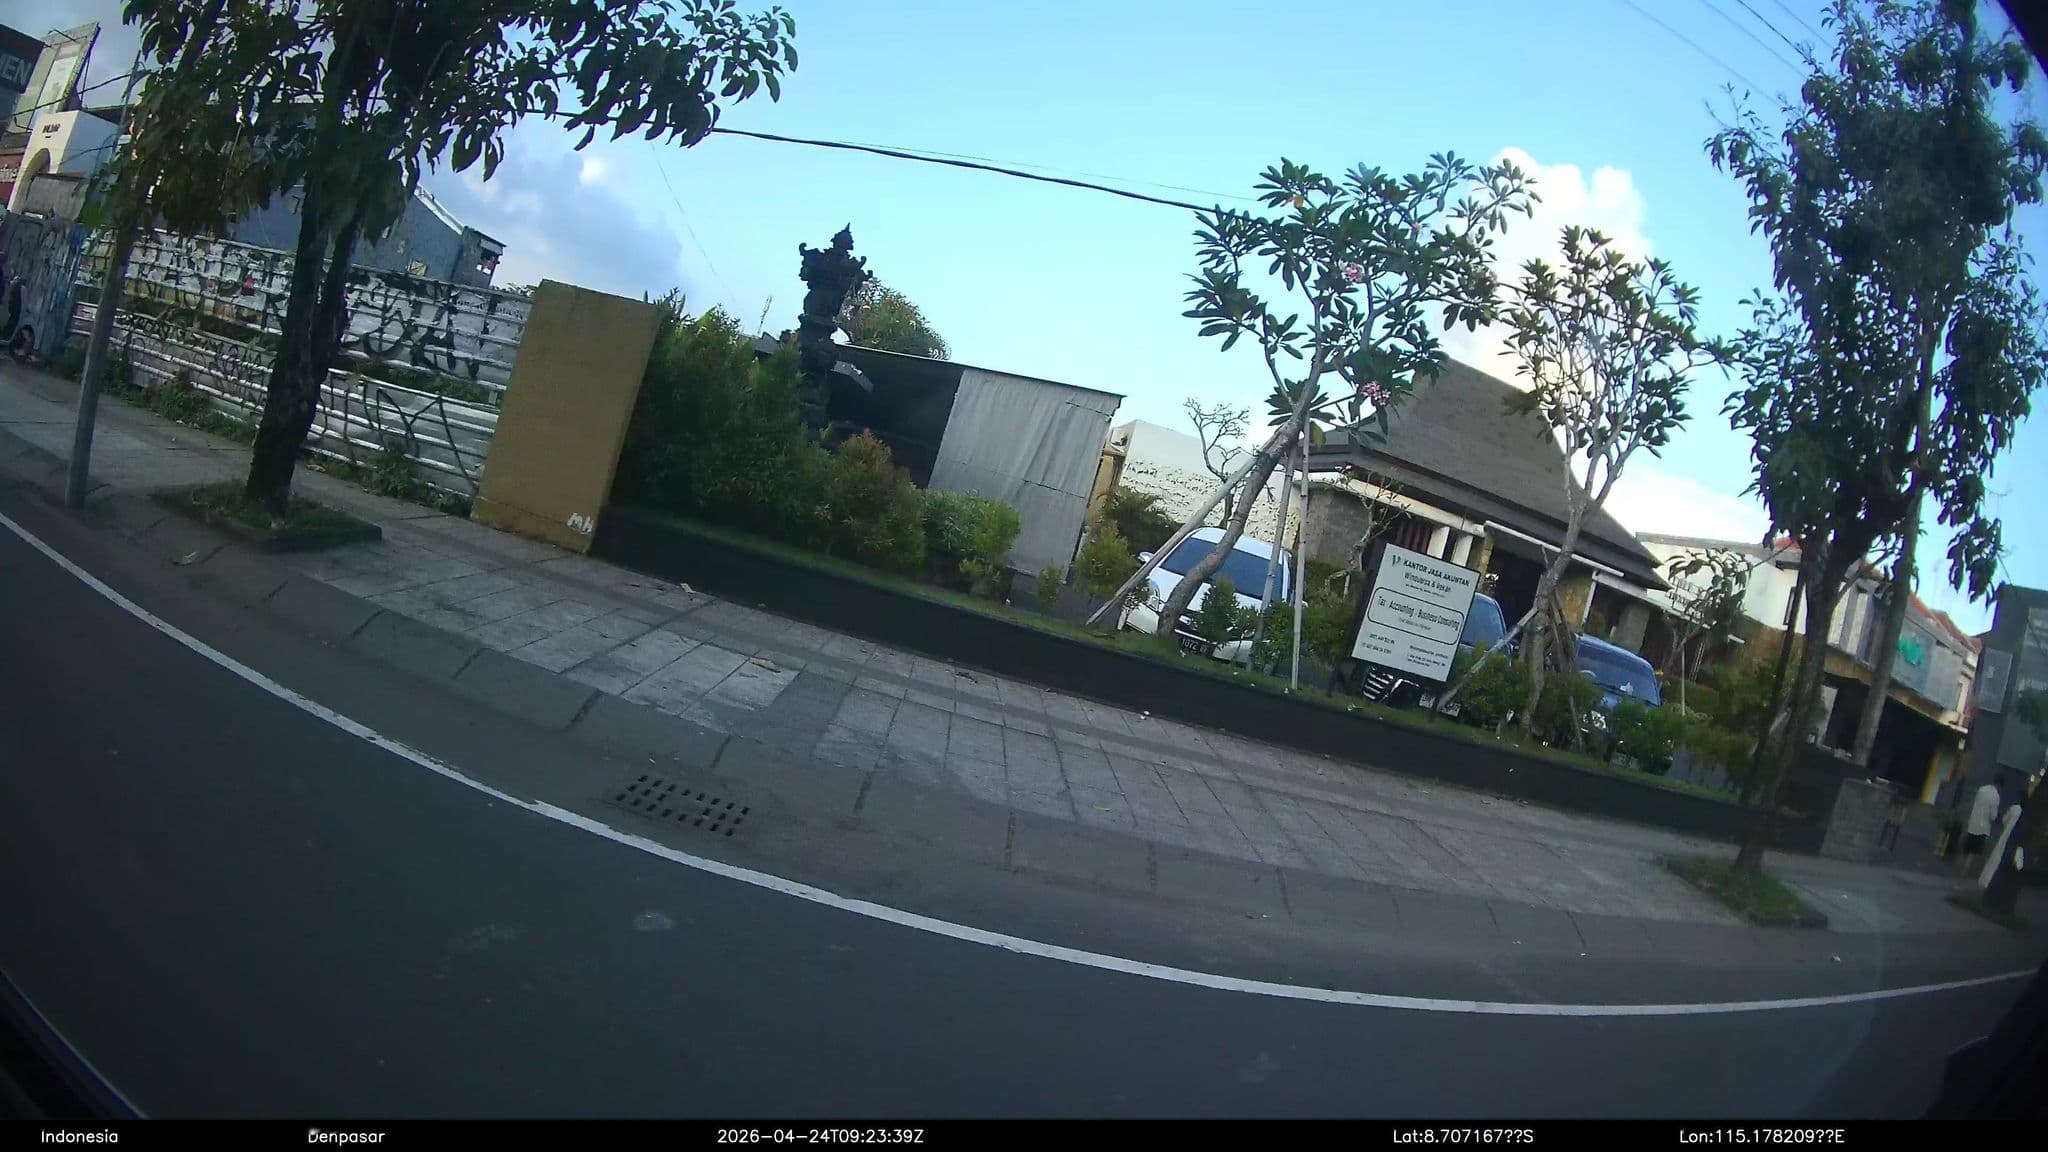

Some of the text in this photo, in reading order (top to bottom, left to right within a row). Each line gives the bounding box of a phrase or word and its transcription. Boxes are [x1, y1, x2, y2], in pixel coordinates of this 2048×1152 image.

[0, 53, 32, 86] EN
[1403, 559, 1470, 587] KANTOR JASA AKUNTAN
[1389, 600, 1415, 617] Accounting
[1418, 609, 1438, 622] Business
